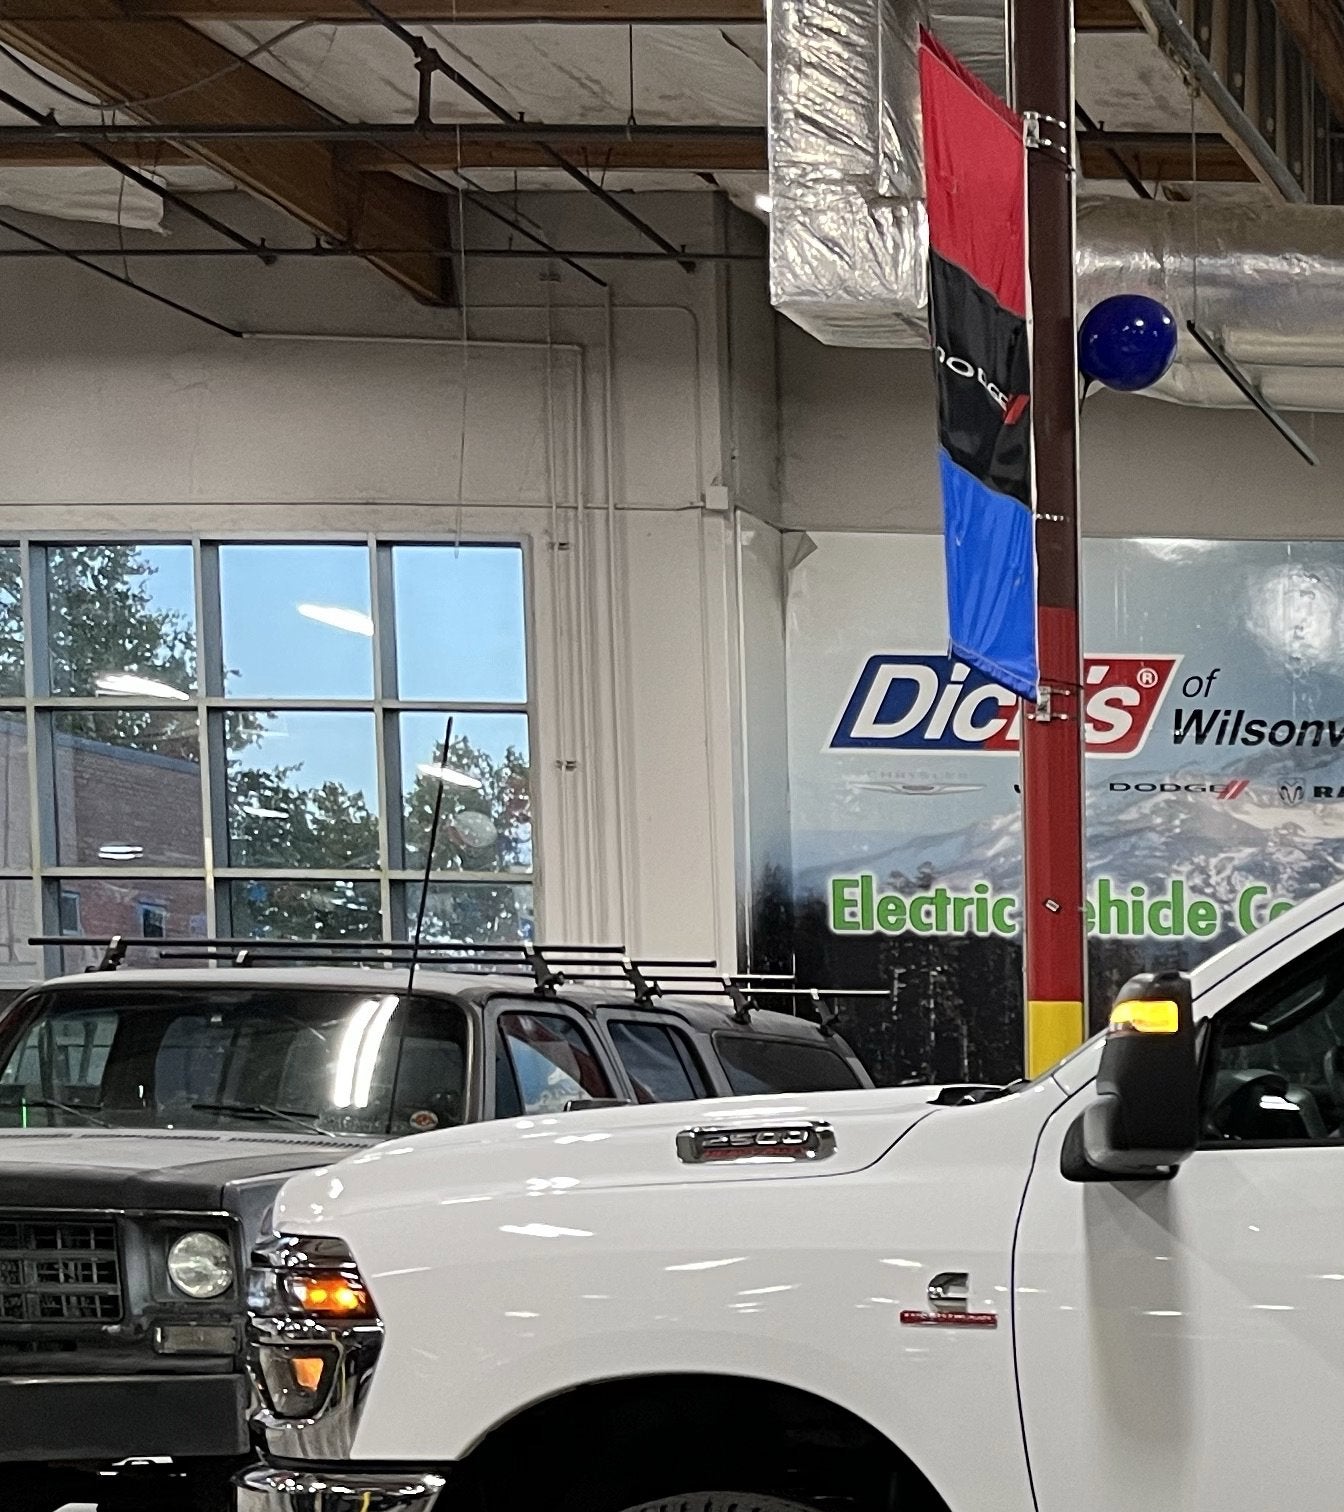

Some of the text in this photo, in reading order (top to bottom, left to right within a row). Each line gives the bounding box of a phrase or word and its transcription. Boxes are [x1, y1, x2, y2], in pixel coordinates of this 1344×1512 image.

[1182, 668, 1221, 698] of
[1109, 782, 1230, 793] DODGE
[832, 875, 1016, 933] Electric
